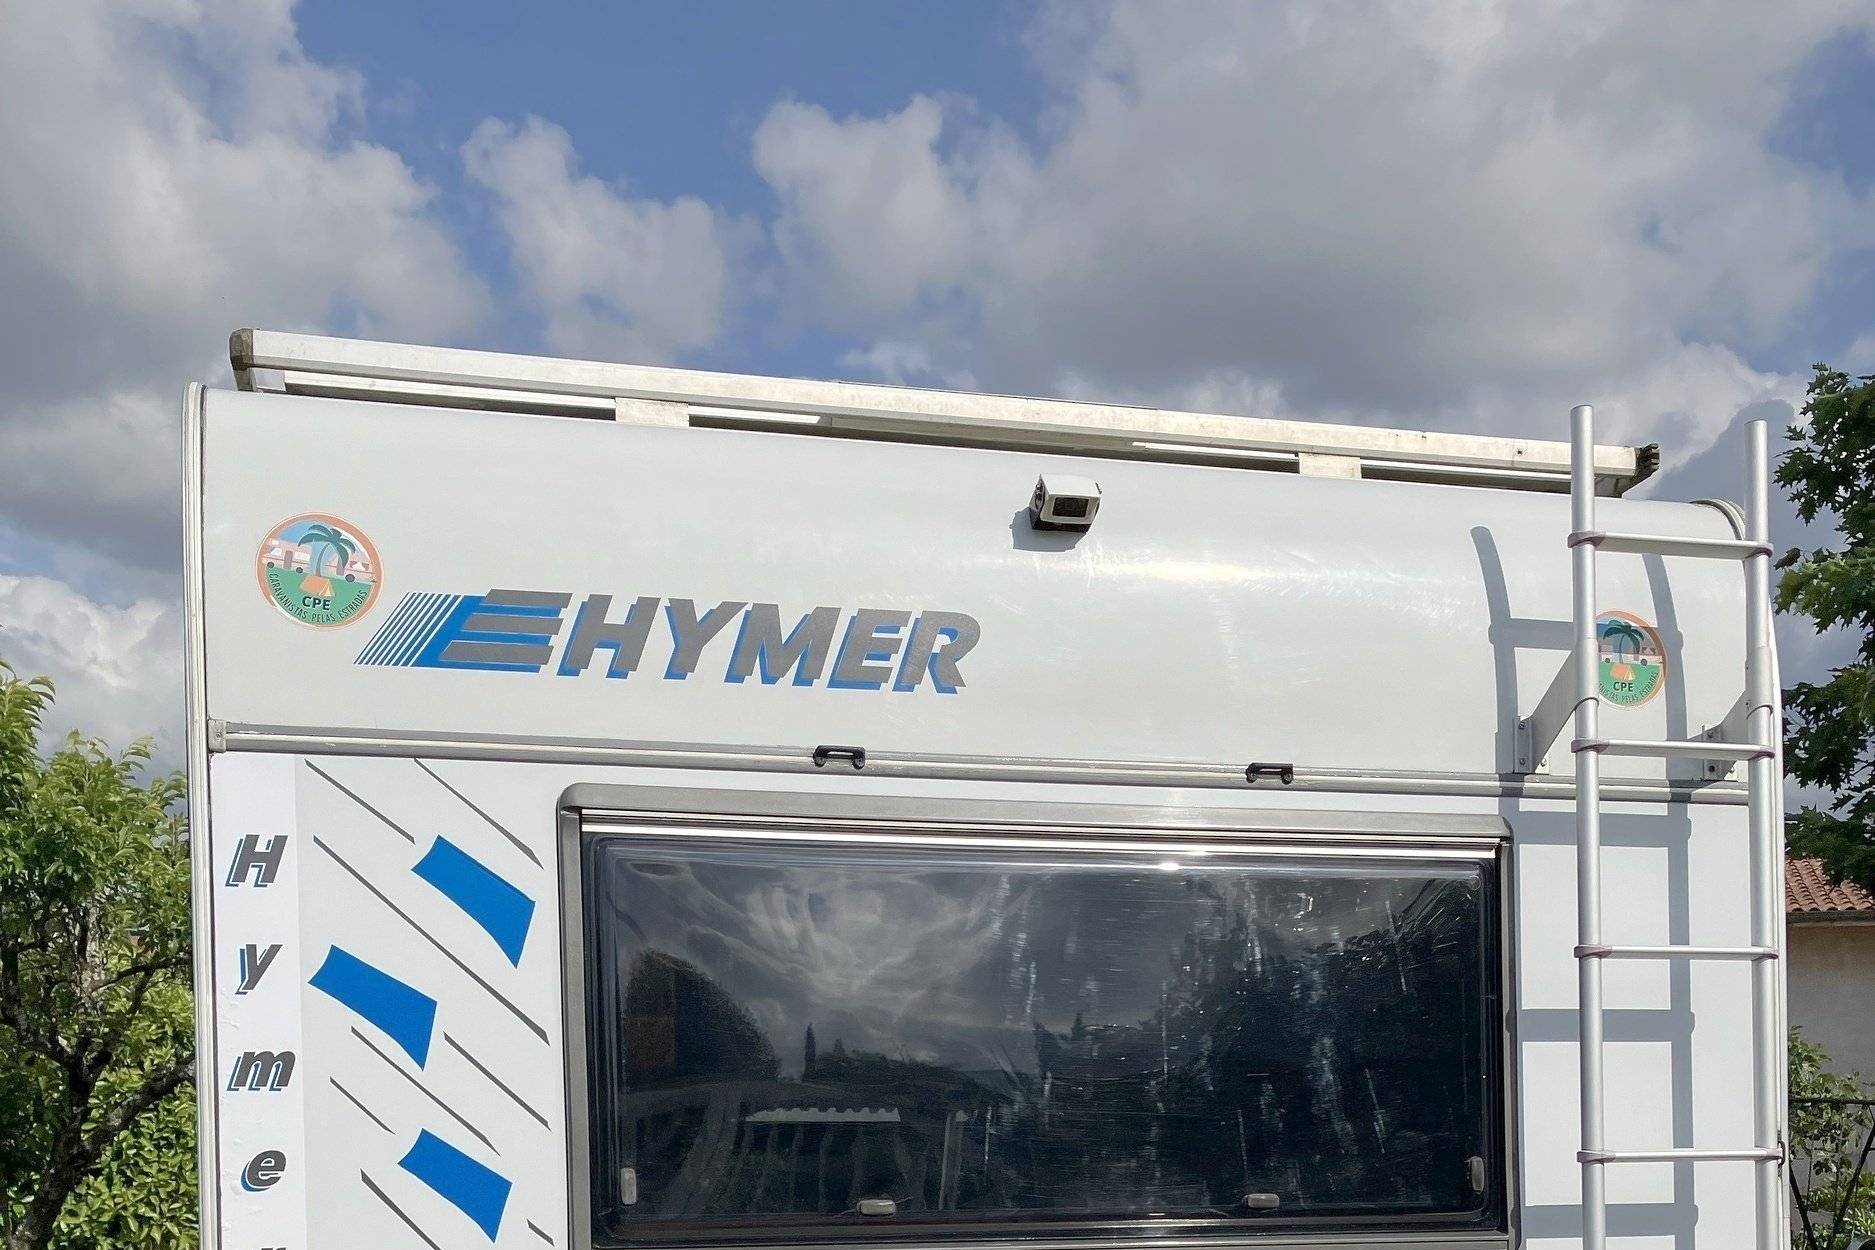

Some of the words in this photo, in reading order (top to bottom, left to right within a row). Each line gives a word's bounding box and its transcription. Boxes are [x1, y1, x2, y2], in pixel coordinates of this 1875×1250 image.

[268, 573, 308, 620] CARAVANISTAS
[311, 612, 336, 623] PELAS
[338, 589, 368, 620] ESTRADAS
[302, 596, 331, 611] CPE
[556, 593, 982, 695] HYMER
[1613, 681, 1634, 692] CPE
